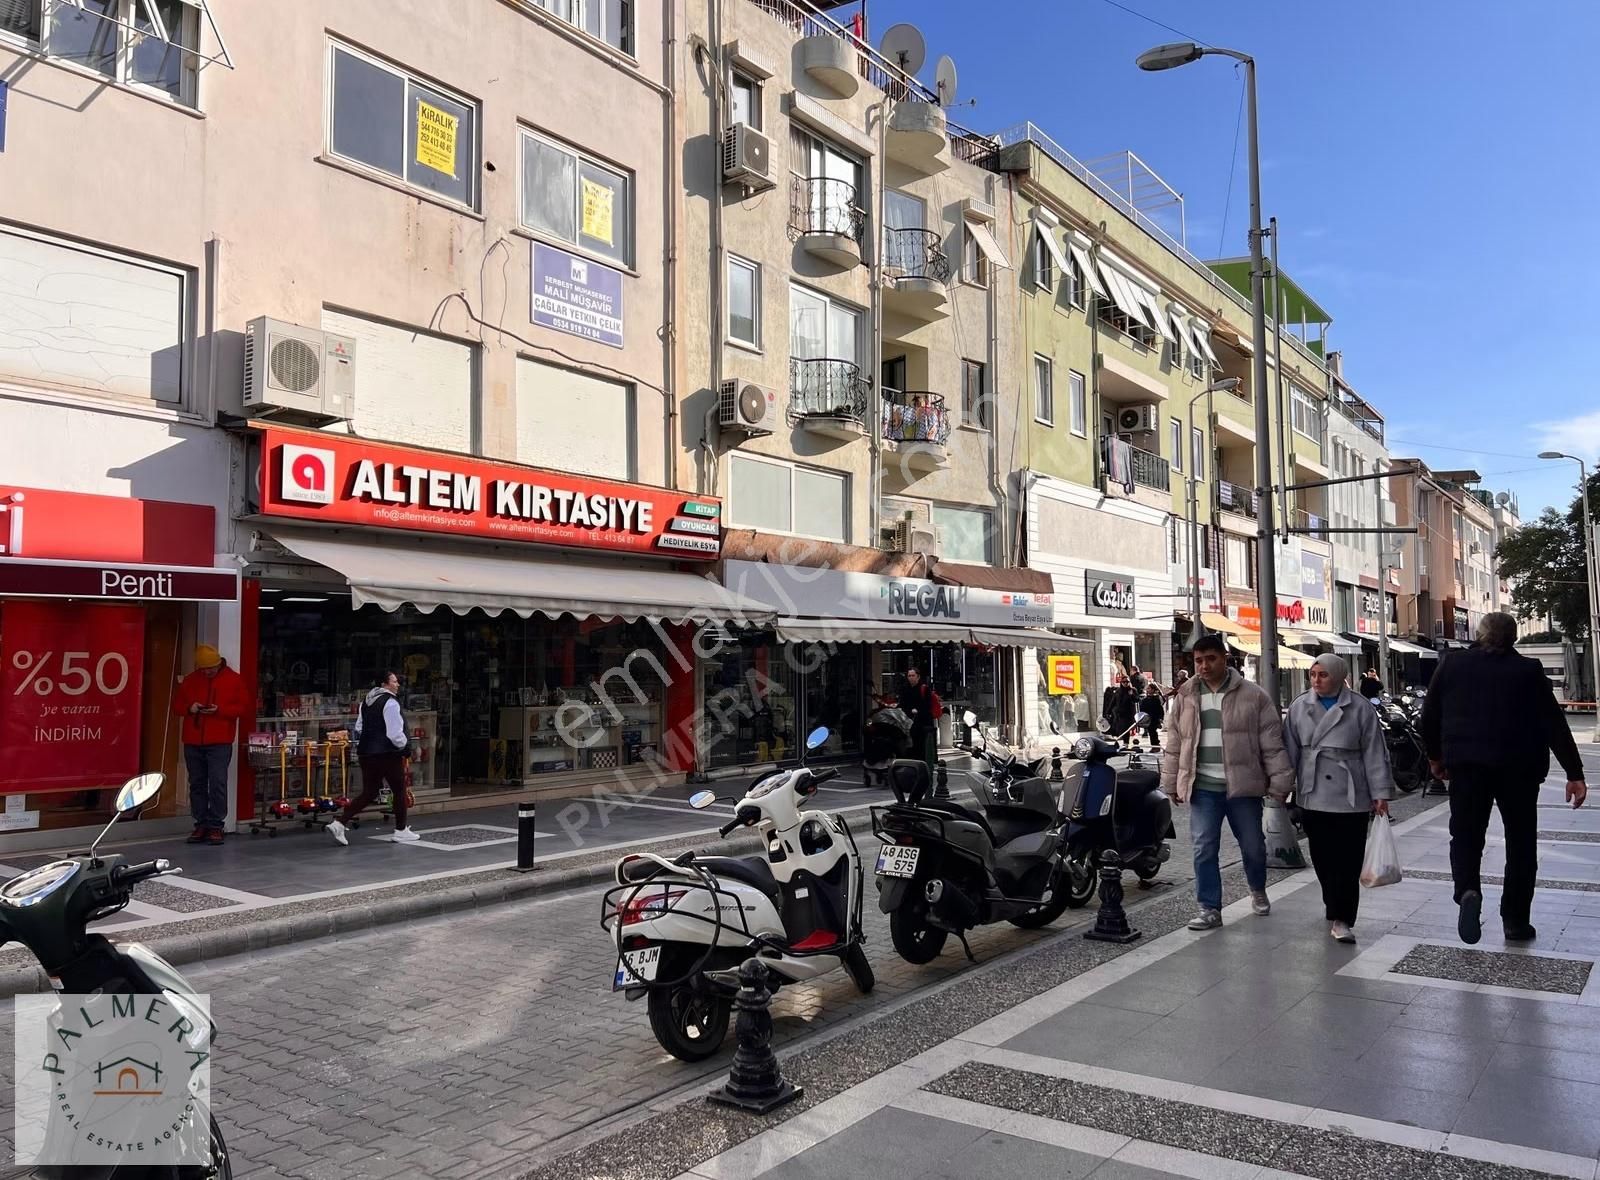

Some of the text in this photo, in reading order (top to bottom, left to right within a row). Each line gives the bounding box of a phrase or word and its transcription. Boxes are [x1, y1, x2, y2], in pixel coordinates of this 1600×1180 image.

[351, 458, 481, 512] ALTEM
[695, 504, 716, 515] KİTAP
[681, 520, 716, 533] OYUNCAK
[101, 569, 173, 597] Penti
[888, 581, 961, 618] REGAL
[12, 650, 129, 696] %50
[61, 703, 101, 715] varan
[34, 725, 101, 743] İNDİRİM
[882, 846, 918, 860] 48 ASG
[894, 859, 915, 872] 575
[638, 948, 659, 965] BJM
